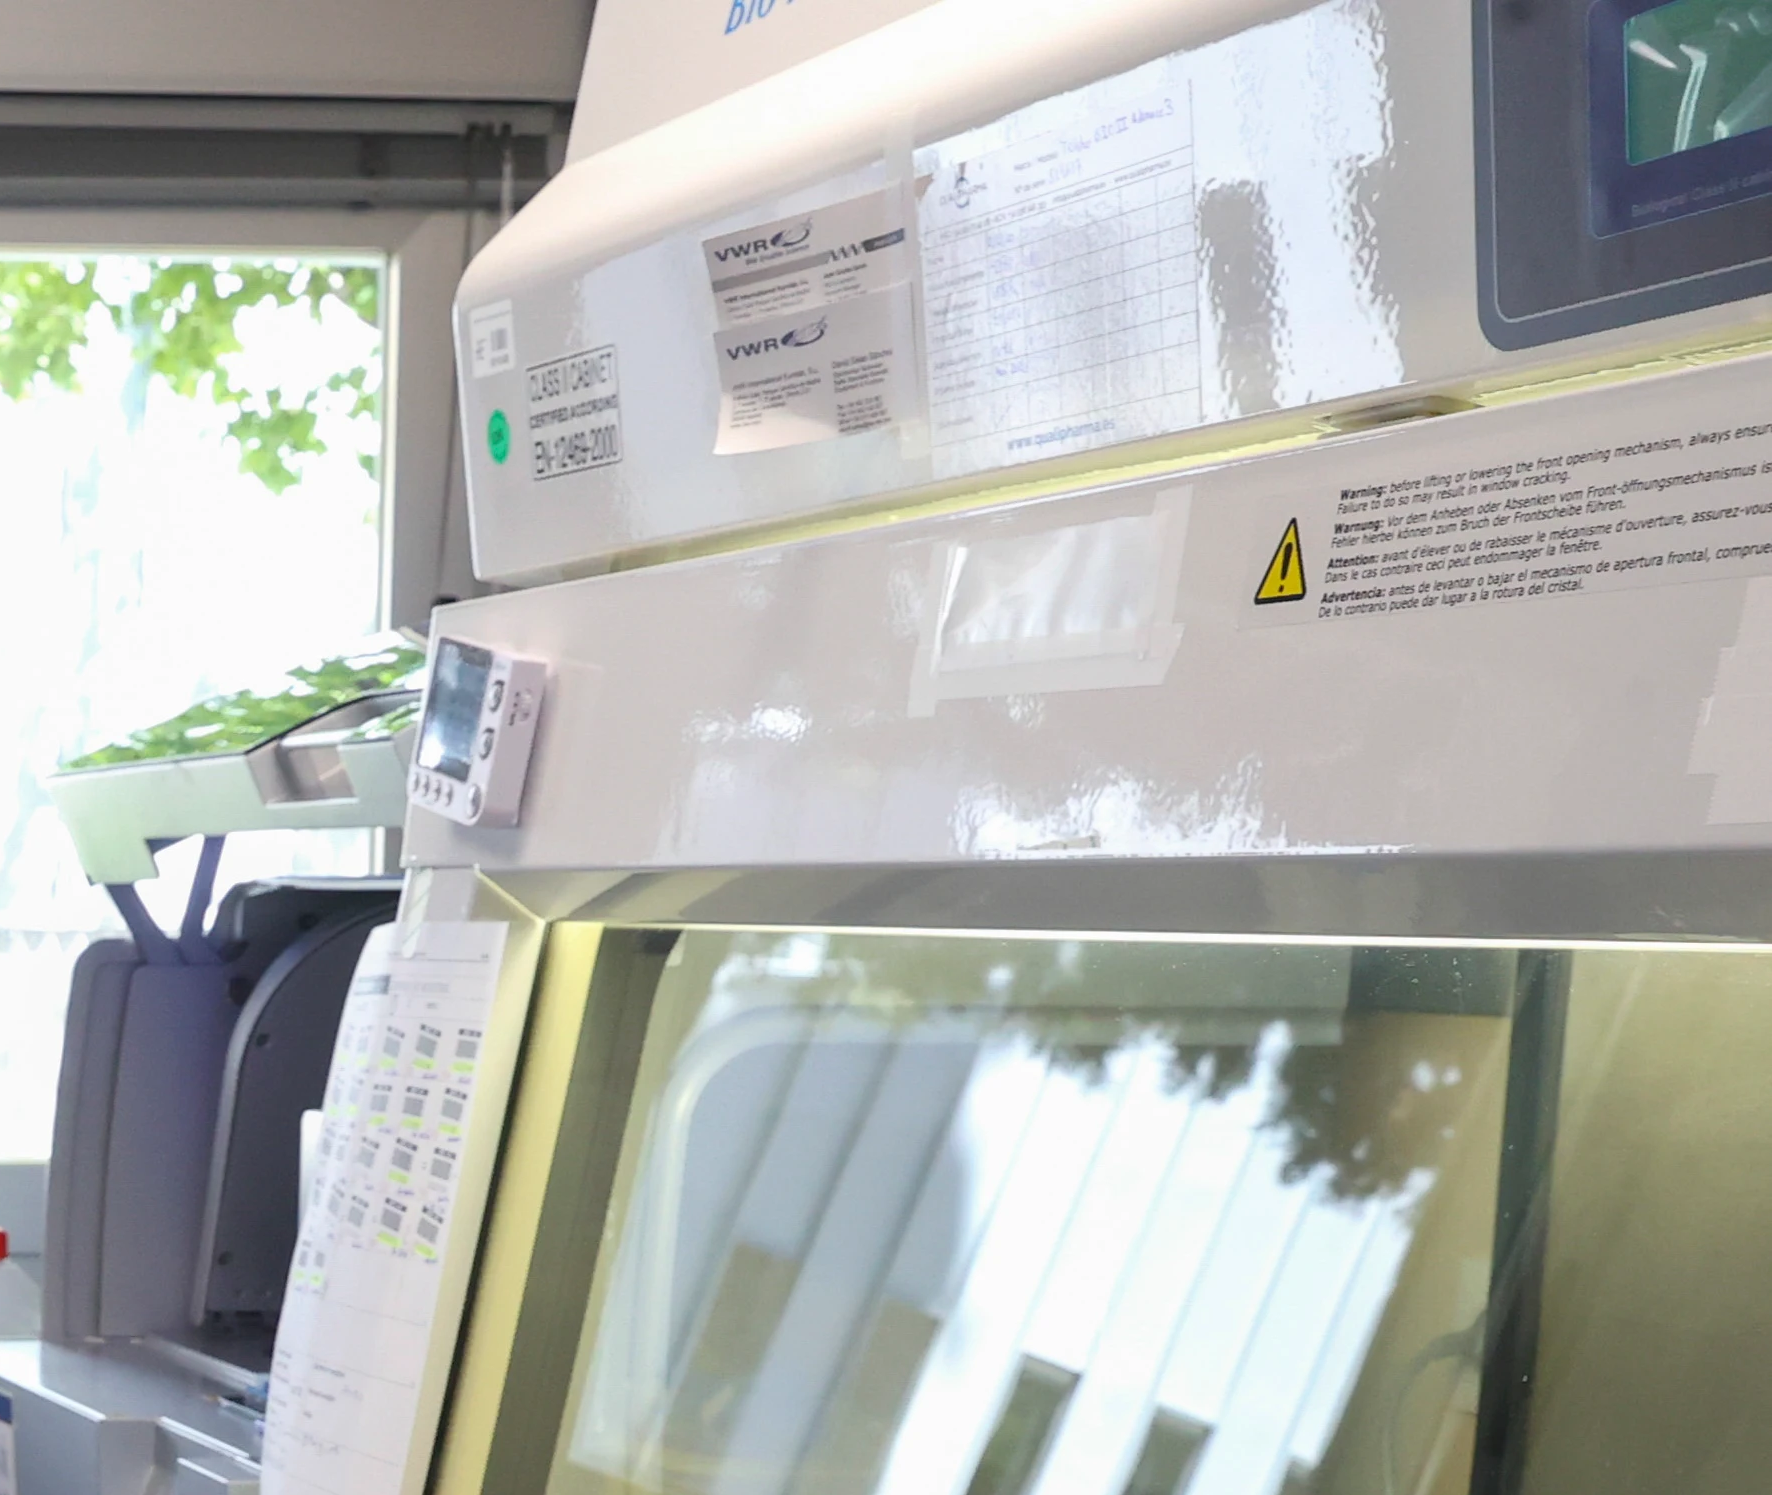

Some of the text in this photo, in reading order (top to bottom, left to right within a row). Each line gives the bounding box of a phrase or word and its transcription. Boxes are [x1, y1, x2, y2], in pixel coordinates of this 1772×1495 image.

[714, 239, 769, 262] VWR
[726, 337, 779, 361] VWR
[1340, 486, 1388, 501] Warning:
[1390, 480, 1421, 494] before
[1423, 475, 1452, 489] lifting
[1455, 471, 1466, 483] or
[1469, 465, 1512, 482] lowering
[1516, 461, 1534, 474] the
[1537, 456, 1562, 470] front
[1566, 449, 1610, 467] opening
[1614, 437, 1684, 458] mechanism,
[1689, 429, 1731, 447] always
[1334, 520, 1385, 534] Warnung:
[1388, 515, 1404, 528] Vor
[1406, 512, 1428, 525] dem
[1430, 504, 1474, 522] Anheben
[1477, 501, 1502, 514] oder
[1503, 492, 1556, 511] Absenken
[1560, 490, 1583, 502] vom
[1337, 470, 1571, 515] Failure to do so may result in window cracking.
[1327, 553, 1380, 569] Attention:
[1381, 548, 1409, 563] avant
[1454, 542, 1466, 553] ou
[1469, 538, 1482, 551] de
[1485, 534, 1533, 548] rabaisser
[1536, 530, 1546, 542] le
[1549, 521, 1612, 540] mécanisme
[1331, 535, 1360, 549] Fehler
[1362, 530, 1394, 543] hierbei
[1397, 523, 1432, 540] können
[1436, 522, 1456, 535] zum
[1460, 518, 1490, 532] Bruch
[1493, 515, 1511, 527] der
[1513, 502, 1582, 524] Frontscheibe
[1321, 587, 1386, 604] Advertencia:
[1388, 582, 1416, 596] antes
[1418, 581, 1431, 593] de
[1433, 573, 1475, 590] levantar
[1486, 570, 1515, 587] bajar
[1518, 567, 1528, 580] el
[1530, 562, 1592, 580] mecanismo
[1596, 558, 1610, 573] de
[1613, 552, 1663, 572] apertura
[1667, 547, 1710, 564] frontal,
[1325, 570, 1348, 583] Dans
[1350, 568, 1359, 580] le
[1362, 568, 1378, 579] cas
[1380, 560, 1423, 578] contraire
[1426, 557, 1446, 571] ceci
[1447, 556, 1471, 571] peut
[1473, 547, 1542, 568] endommager
[1546, 544, 1557, 556] la
[1318, 605, 1331, 618] De
[1334, 604, 1343, 616] lo
[1344, 599, 1386, 616] contrario
[1389, 597, 1419, 612] puede
[1422, 593, 1442, 607] dar
[1442, 590, 1468, 608] lugar
[1480, 588, 1489, 600] la
[1492, 584, 1525, 600] rotura
[1526, 582, 1545, 596] del
[1547, 578, 1584, 593] cristal.
